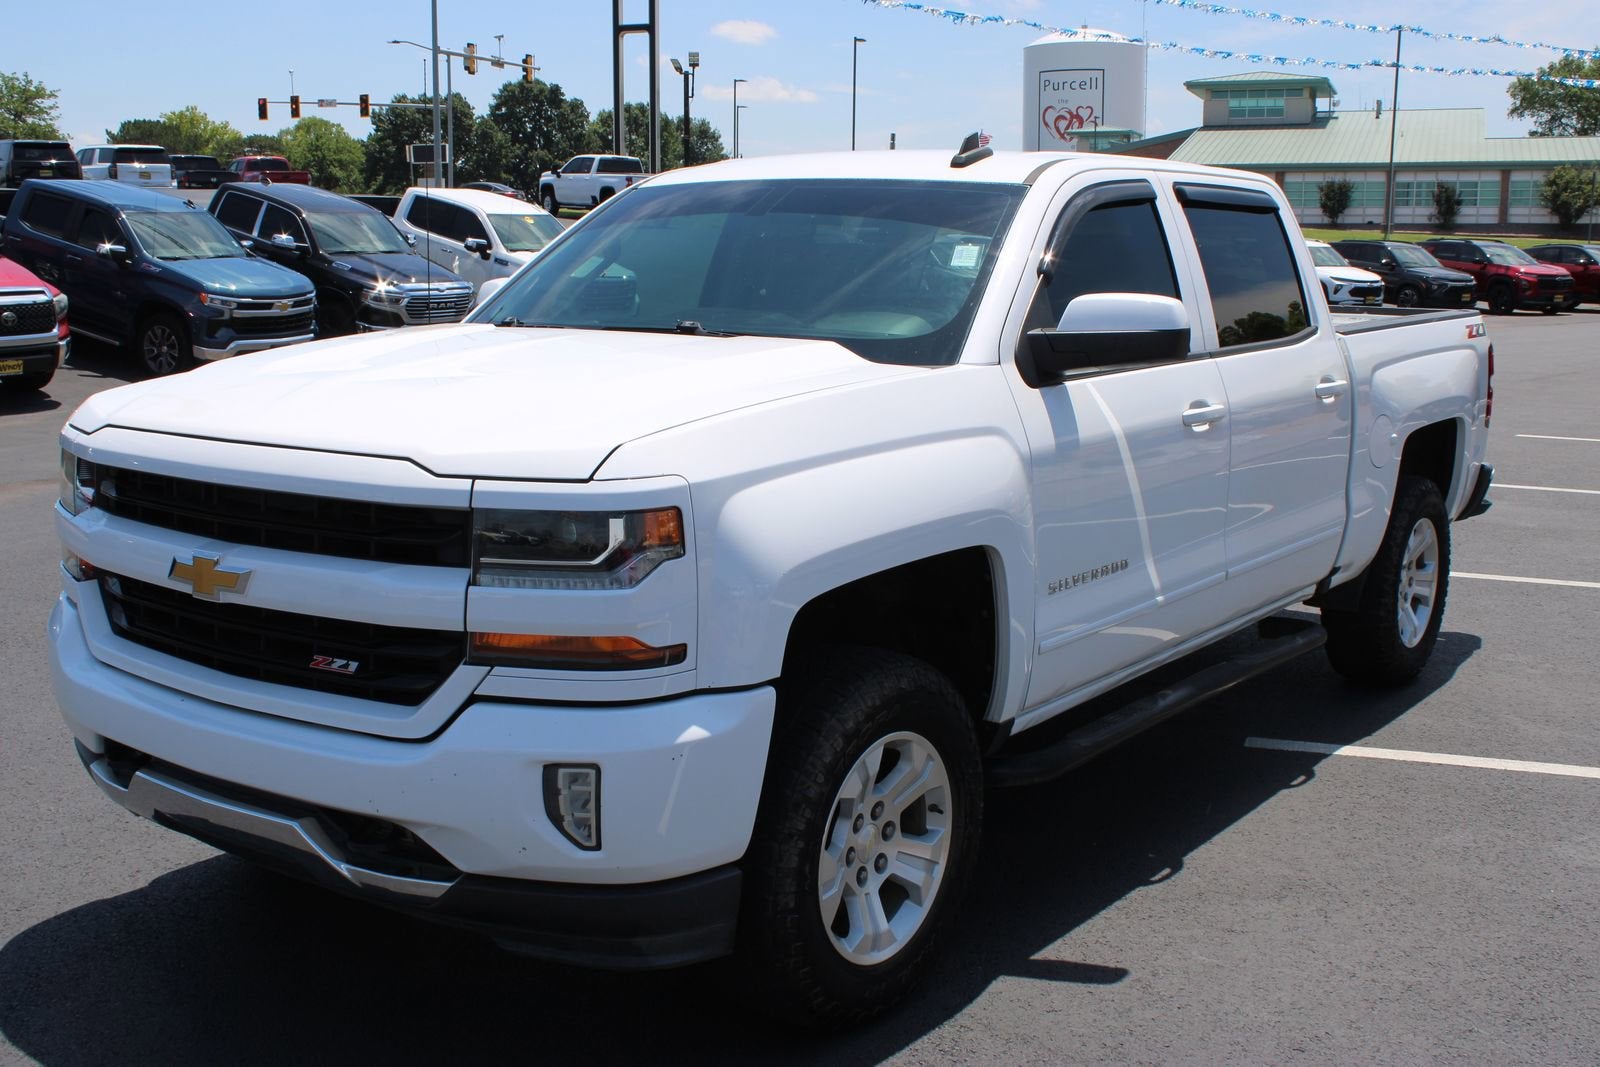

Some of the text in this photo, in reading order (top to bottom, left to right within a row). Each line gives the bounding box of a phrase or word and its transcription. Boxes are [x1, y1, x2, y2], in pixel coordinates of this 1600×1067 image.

[1043, 76, 1099, 92] Purcell
[1465, 322, 1487, 339] Z71
[1047, 558, 1129, 596] SILVERADO
[309, 654, 360, 674] Z71
